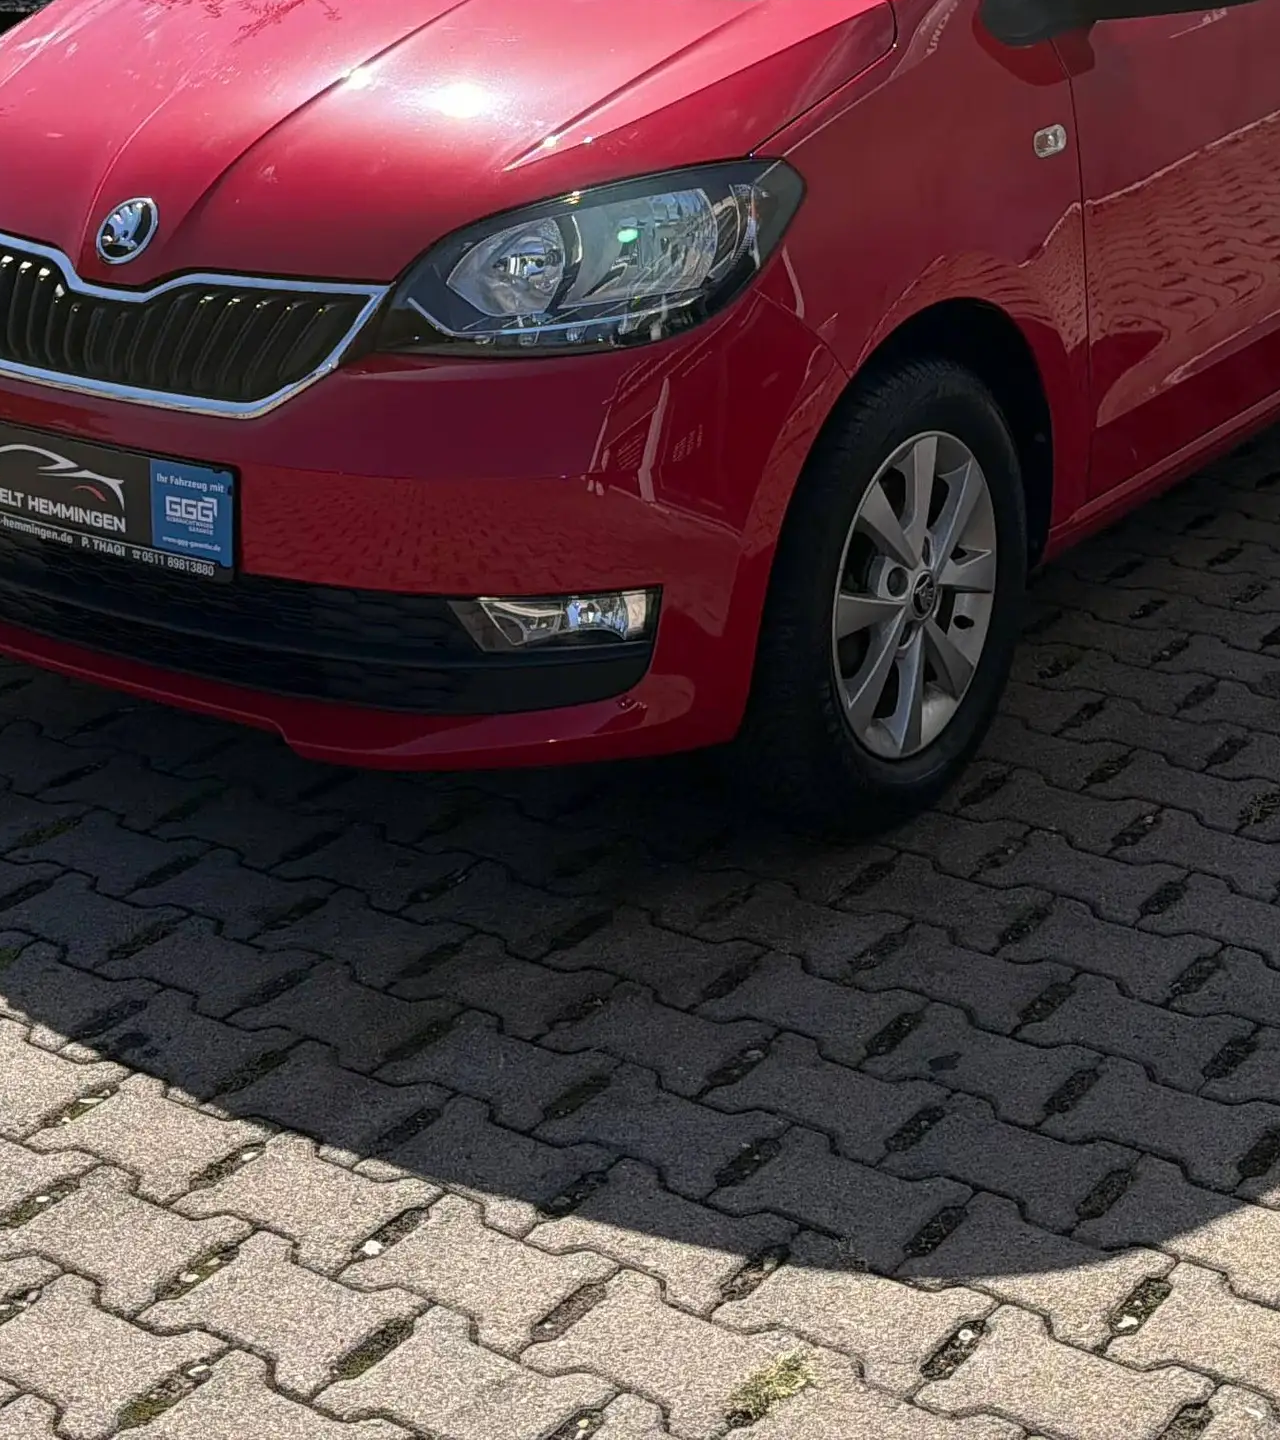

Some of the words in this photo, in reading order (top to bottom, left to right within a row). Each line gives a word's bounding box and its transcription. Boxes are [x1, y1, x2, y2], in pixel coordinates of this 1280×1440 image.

[156, 472, 168, 484] Ihr
[170, 475, 208, 493] Fahrzeug
[209, 483, 224, 494] mit
[28, 494, 126, 534] HEMMINGEN
[165, 495, 214, 523] GGG
[81, 536, 90, 548] P.
[93, 539, 126, 557] THAQI
[142, 550, 165, 566] 0511
